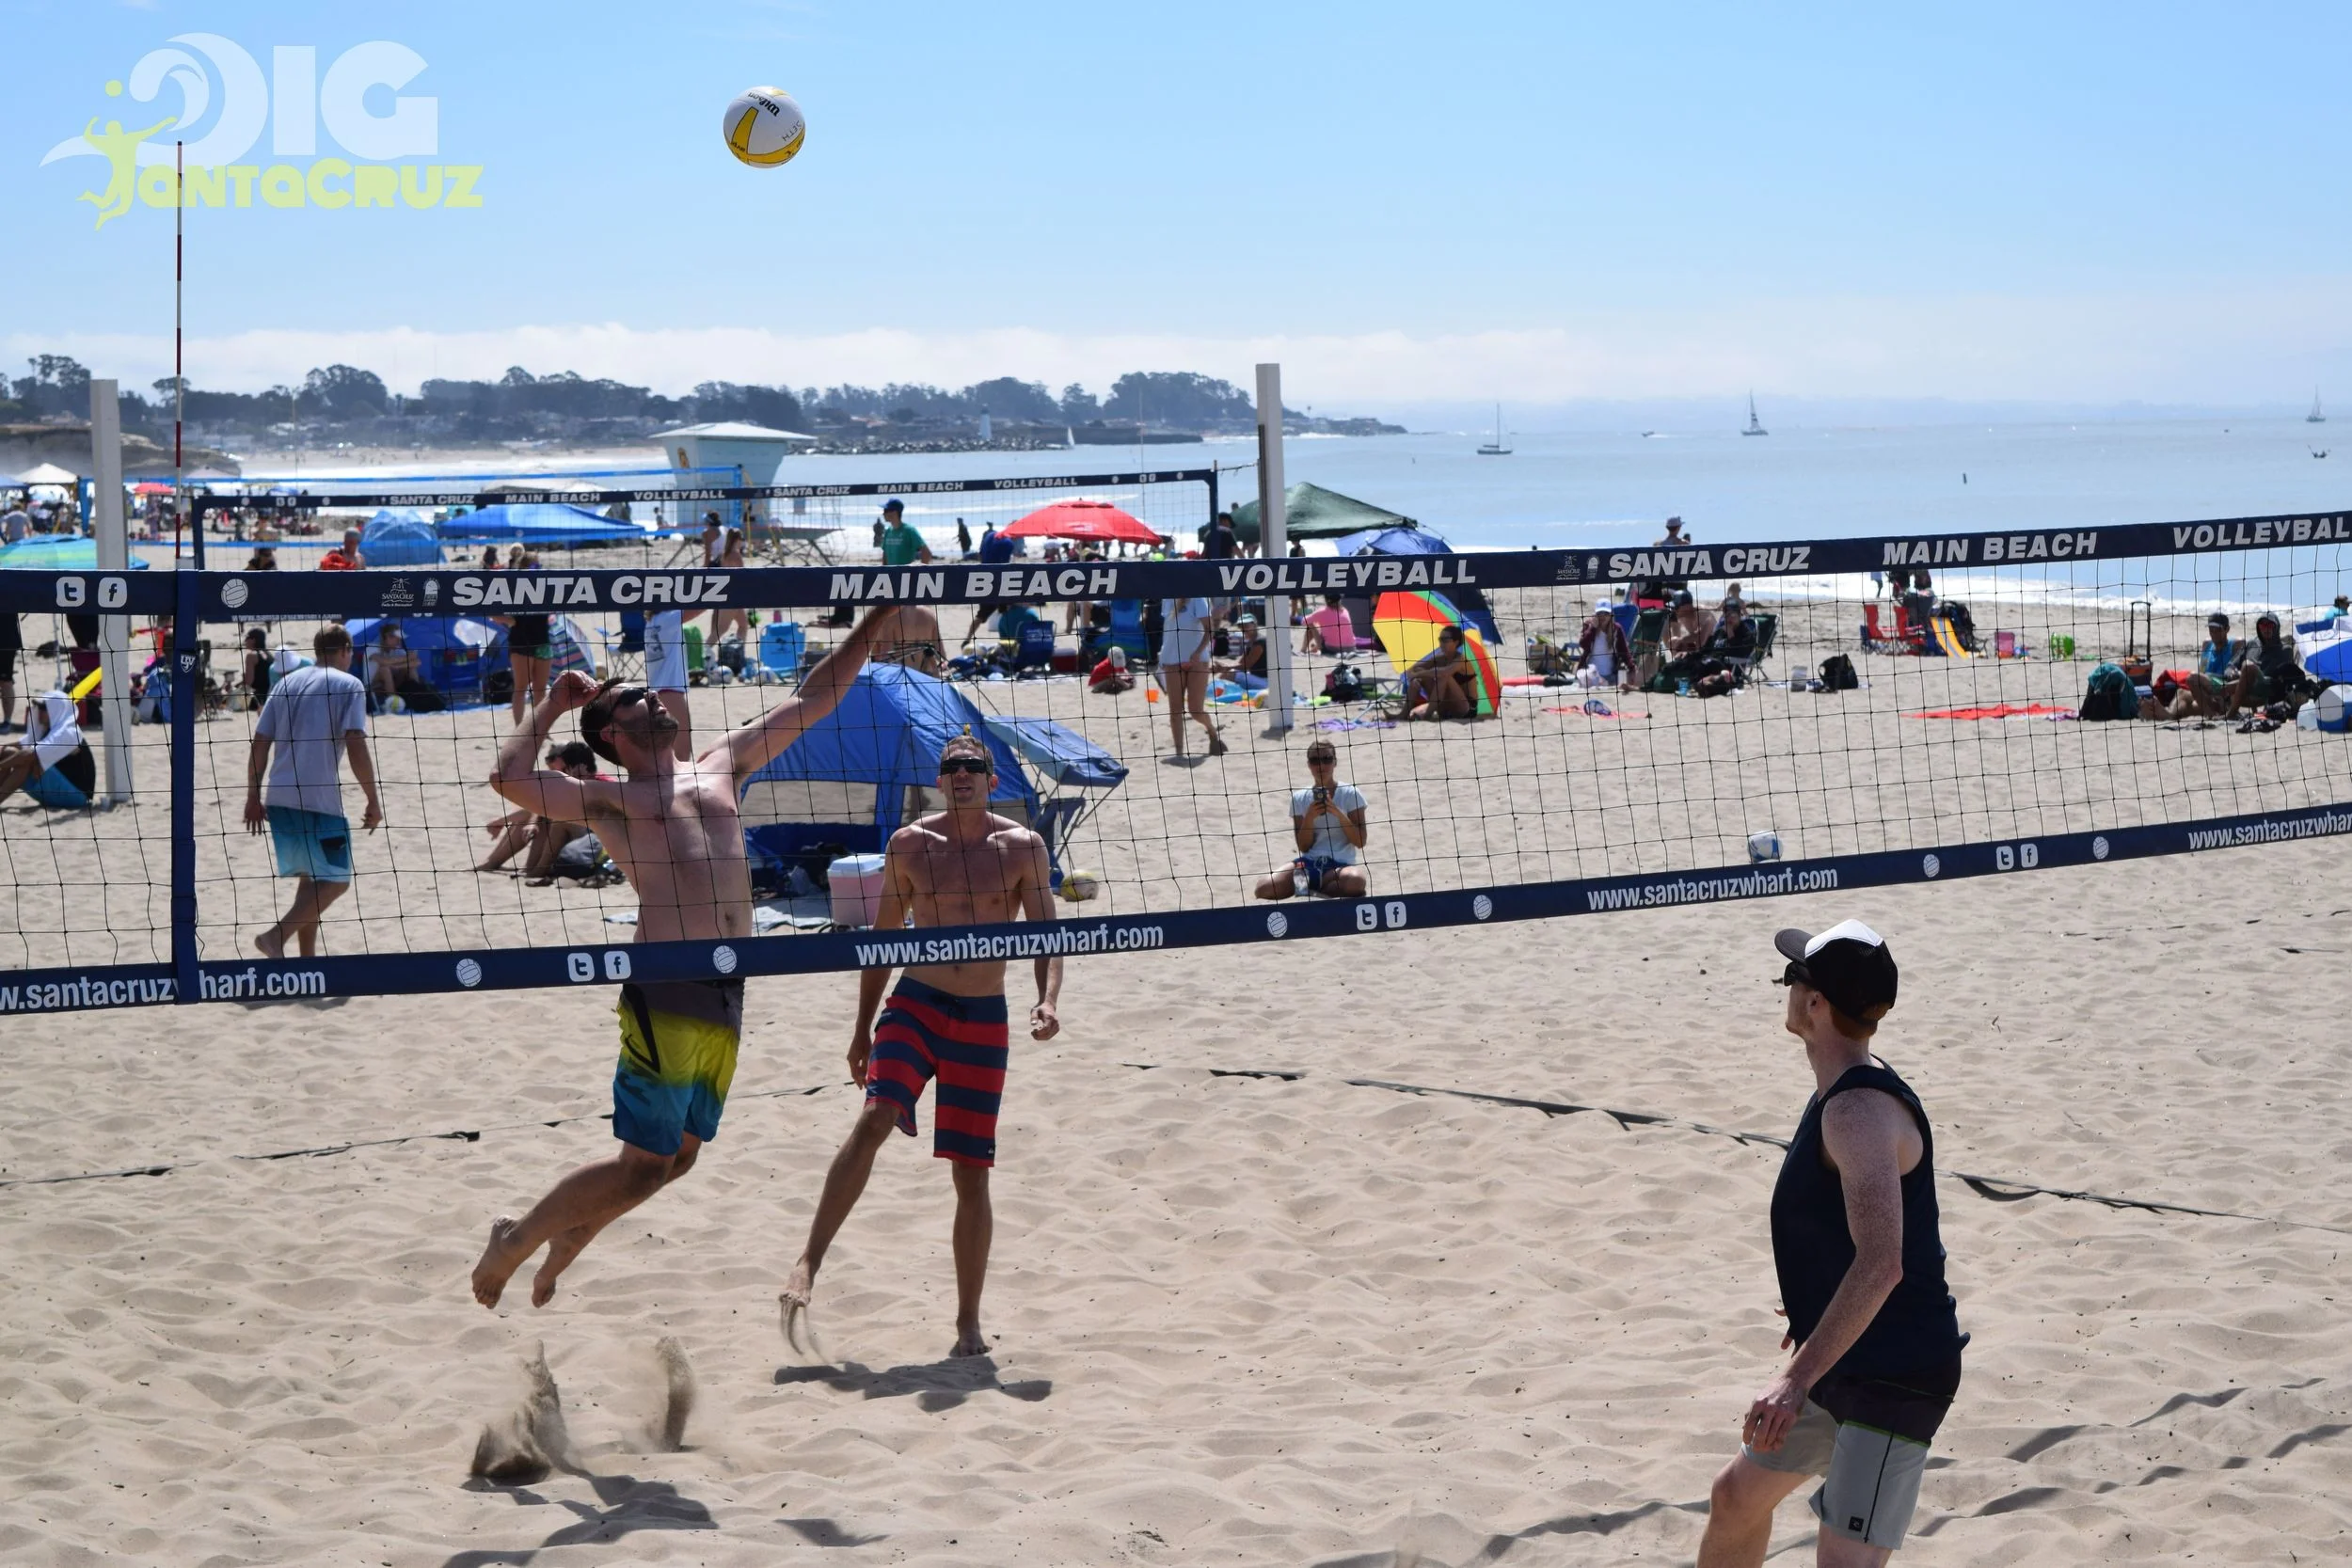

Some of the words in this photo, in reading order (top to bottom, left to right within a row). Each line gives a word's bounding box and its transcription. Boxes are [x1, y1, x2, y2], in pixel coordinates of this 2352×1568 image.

[748, 92, 780, 117] Wilson
[389, 495, 434, 505] SANTA
[437, 495, 475, 504] CRUZ
[504, 494, 544, 503] MAIN
[548, 492, 600, 502] BEACH
[633, 489, 726, 500] VOLLEYBALL
[773, 487, 814, 497] SANTA
[817, 485, 850, 495] CRUZ
[877, 483, 913, 493] MAIN
[916, 482, 964, 492] BEACH
[993, 477, 1078, 489] VOLLEYBALL
[453, 577, 596, 606] SANTA
[611, 576, 731, 604] CRUZ
[829, 572, 945, 600] MAIN
[964, 569, 1118, 597] BEACH
[1218, 560, 1476, 591] VOLLEYBALL
[1608, 550, 1713, 578] SANTA
[1723, 546, 1811, 574] CRUZ
[1882, 539, 1969, 565] MAIN
[1983, 531, 2097, 561] BEACH
[2173, 516, 2351, 548] VOLLEYBAL
[1587, 867, 1838, 911] www.santacruzwharf.com
[855, 923, 1164, 966] www.santacruzwharf.com
